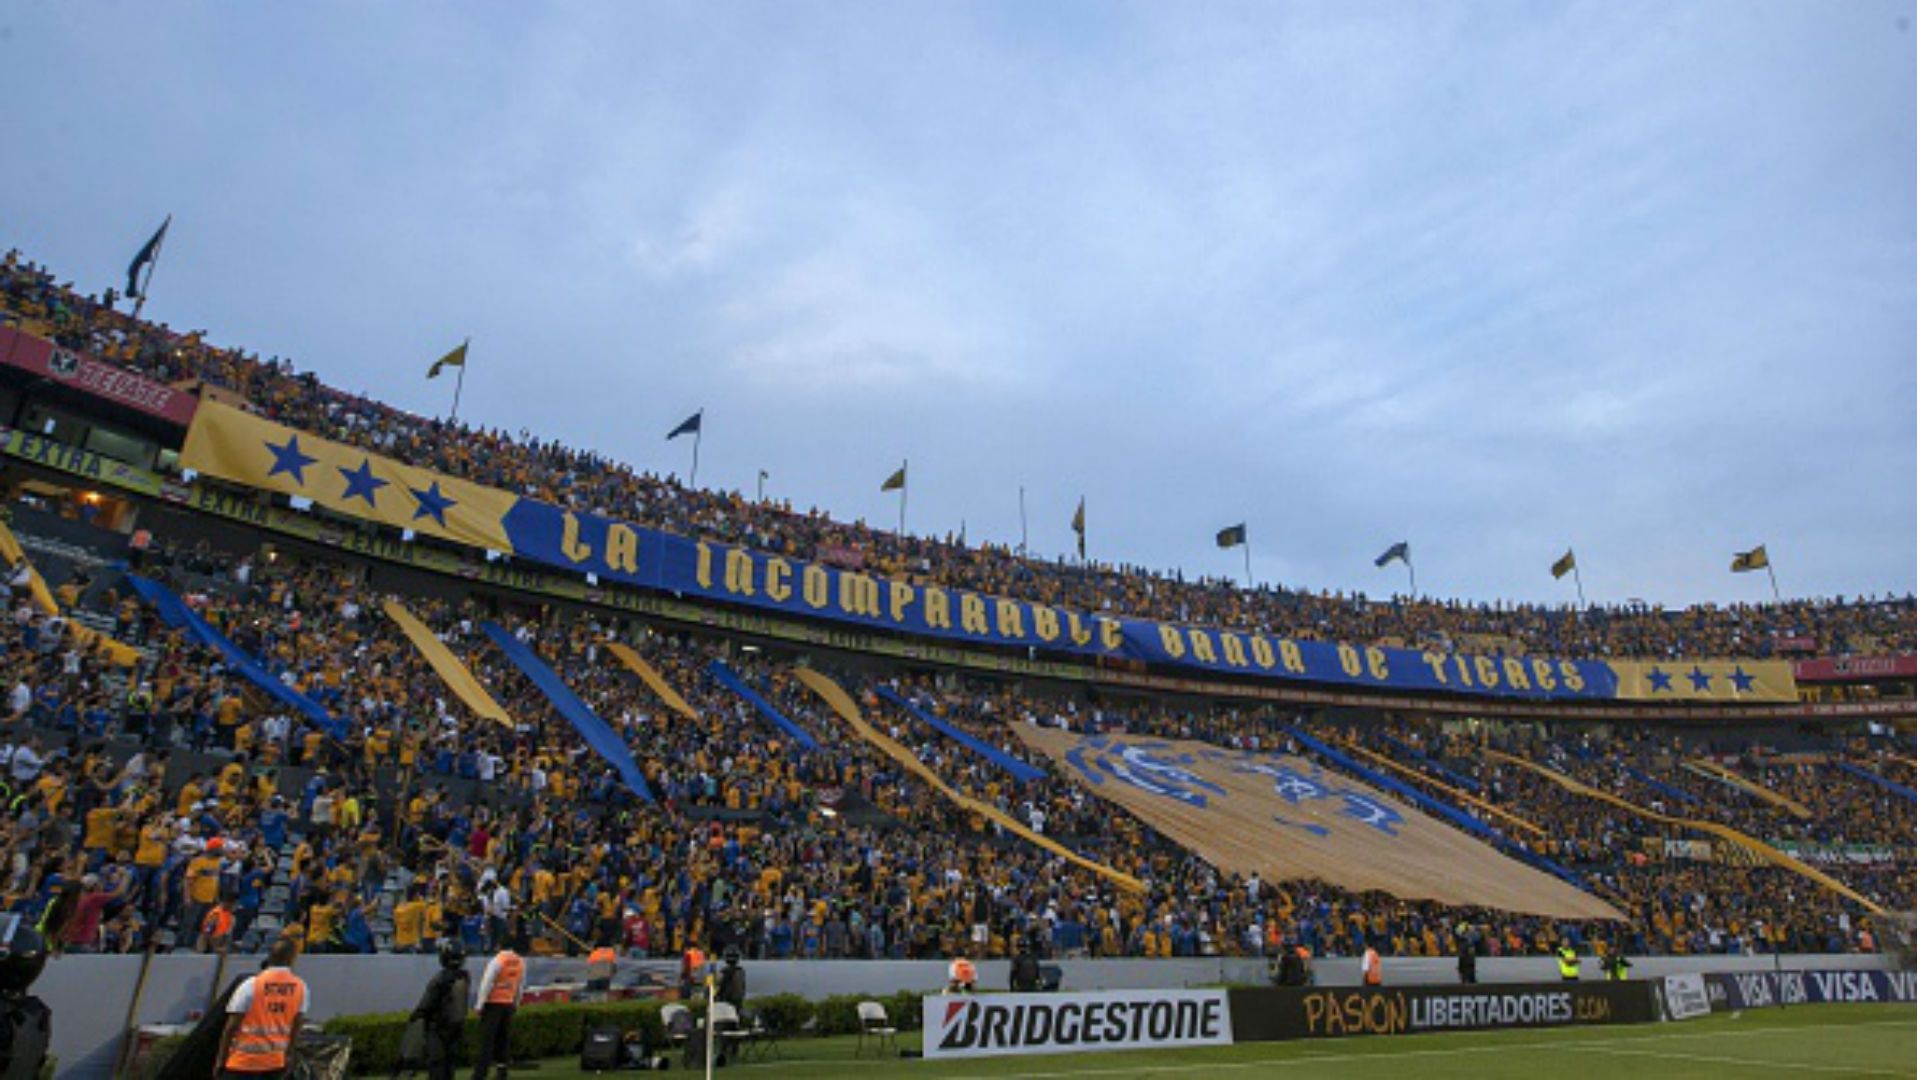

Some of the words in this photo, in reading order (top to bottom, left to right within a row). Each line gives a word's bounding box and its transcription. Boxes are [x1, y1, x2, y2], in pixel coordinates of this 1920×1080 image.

[21, 431, 101, 477] EXTRA
[561, 511, 638, 573] LA
[696, 541, 1122, 650] INCOMPARABLE
[1158, 623, 1304, 673] BANDA
[1337, 639, 1389, 680] DE
[1423, 651, 1585, 692] TIGRES
[1811, 971, 1878, 1000] VISA
[938, 999, 1221, 1050] BRIDGESTONE
[1411, 993, 1571, 1026] LIBERTADORES
